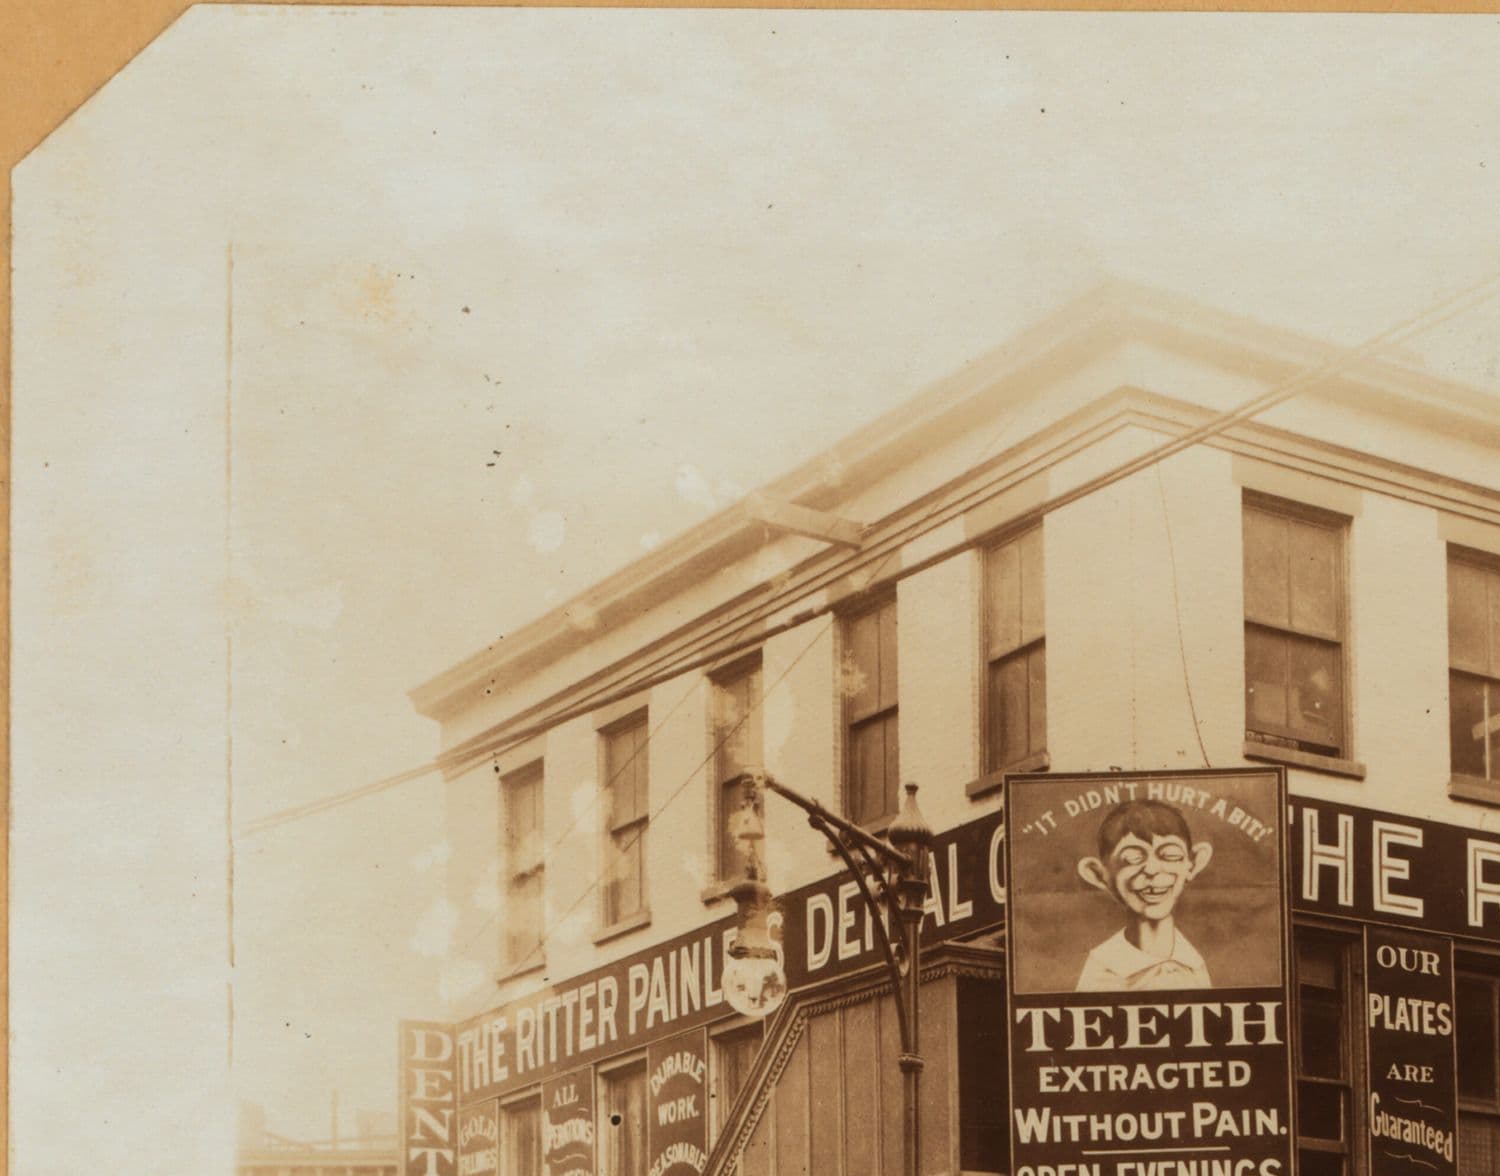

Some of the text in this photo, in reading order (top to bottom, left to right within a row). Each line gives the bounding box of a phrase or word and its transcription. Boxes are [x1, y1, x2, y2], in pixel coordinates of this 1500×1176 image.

[1065, 783, 1138, 818] DIDN'T
[1148, 782, 1211, 809] HURT
[1210, 803, 1225, 820] A
[1288, 804, 1424, 918] HE
[457, 1017, 509, 1093] THE
[515, 975, 618, 1074] RITTER
[628, 911, 785, 1035] PAINLS
[806, 842, 973, 973] DENAL
[1376, 944, 1441, 976] OUR
[1016, 1001, 1284, 1052] TEETH
[1369, 992, 1452, 1036] PLATES
[650, 1051, 706, 1096] DURABLE
[1038, 1060, 1251, 1093] EXTRACTED
[1386, 1063, 1435, 1084] ARE
[552, 1082, 579, 1108] ALL
[657, 1095, 699, 1127] WORK.
[461, 1115, 497, 1148] GOLD
[1014, 1102, 1288, 1143] WITHOUT PAIN.
[1370, 1091, 1453, 1163] Guaranteed
